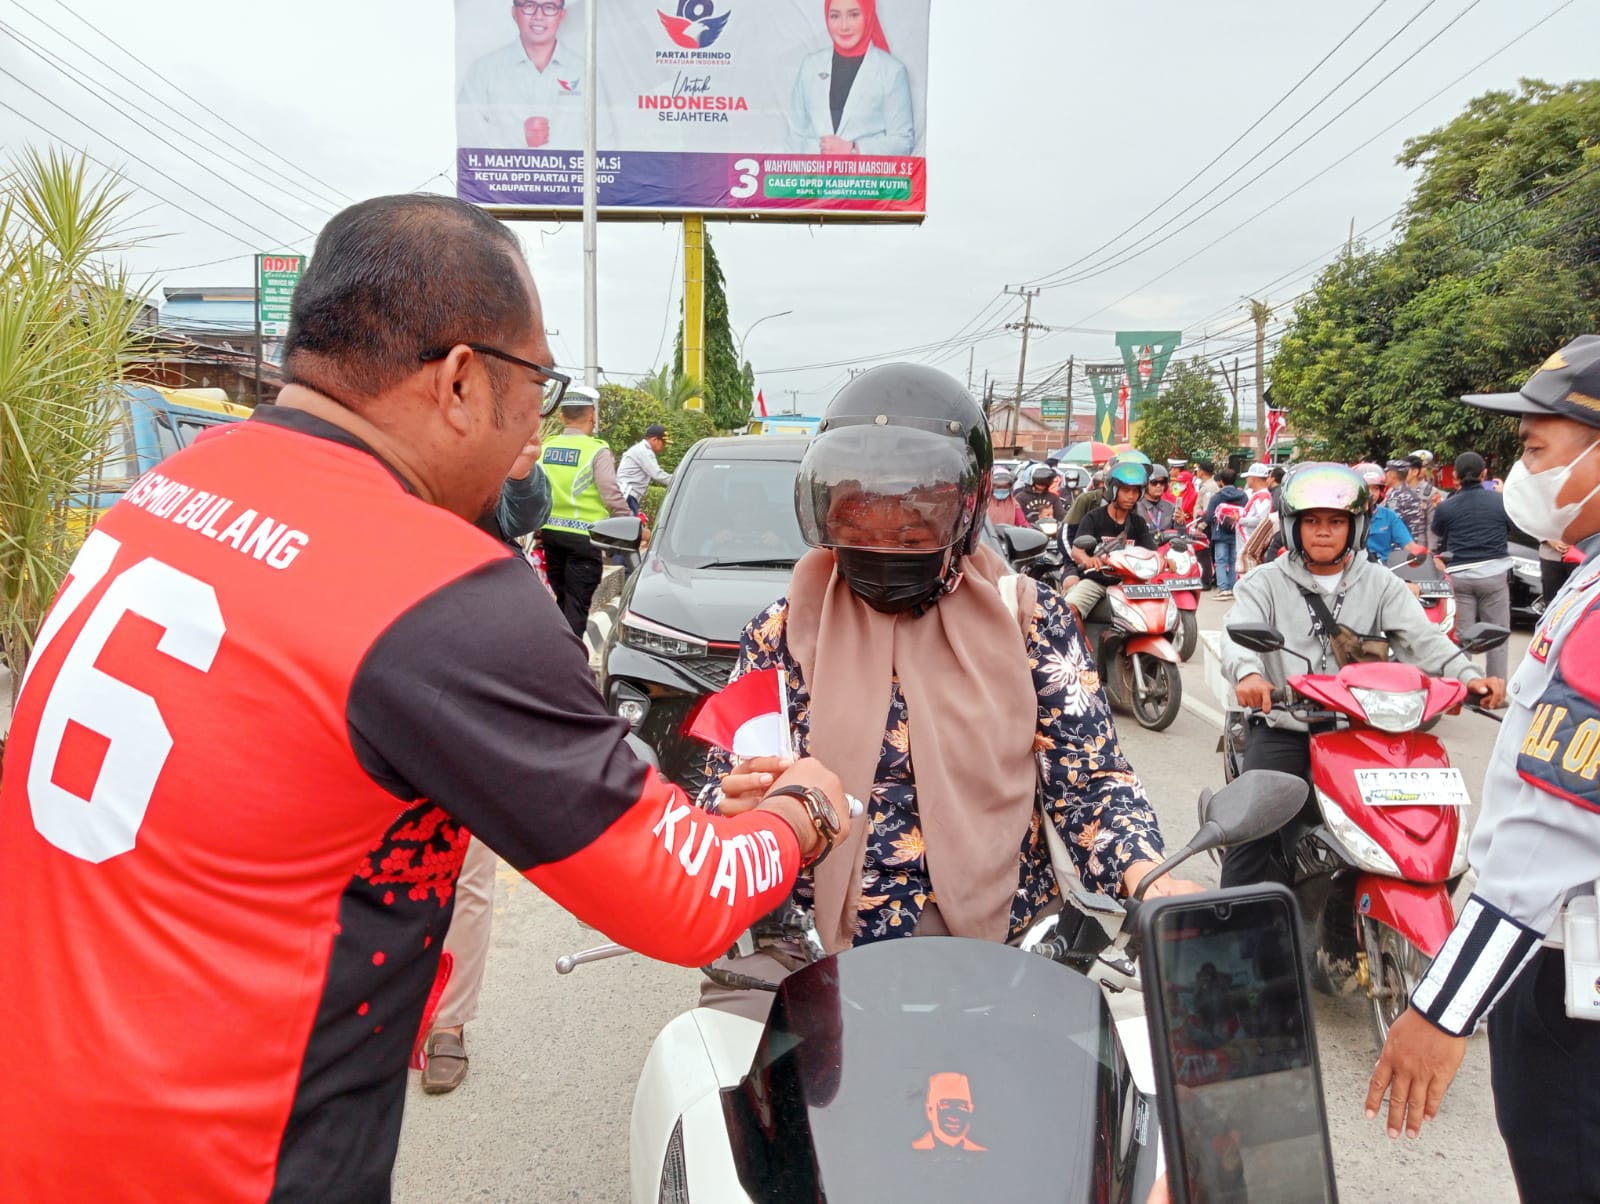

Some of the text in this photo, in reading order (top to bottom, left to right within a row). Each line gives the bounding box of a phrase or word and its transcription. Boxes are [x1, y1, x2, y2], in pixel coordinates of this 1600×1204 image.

[655, 51, 731, 60] PARTAI PERINDO
[672, 70, 711, 99] Untuk
[638, 95, 748, 111] INDONESIA
[658, 111, 729, 122] SEJAHTERA
[468, 154, 482, 167] H.
[484, 155, 567, 170] MAHYUNADI,
[764, 159, 825, 173] WAHYUNINGSIH
[826, 161, 832, 173] P
[833, 161, 857, 174] PUTRI
[858, 162, 897, 175] MARSIDIK
[475, 172, 615, 184] KETUA DPD PARTAI PENDO
[730, 158, 760, 198] 3
[768, 178, 908, 190] CALEG DPRD KABUPATEN KUTIM
[489, 184, 541, 193] KABUPATEN
[543, 185, 570, 193] KUTAI
[263, 256, 299, 272] ADIT
[544, 449, 579, 463] POLISI
[120, 471, 310, 570] ASMIDI BULANG
[10, 528, 228, 865] 76
